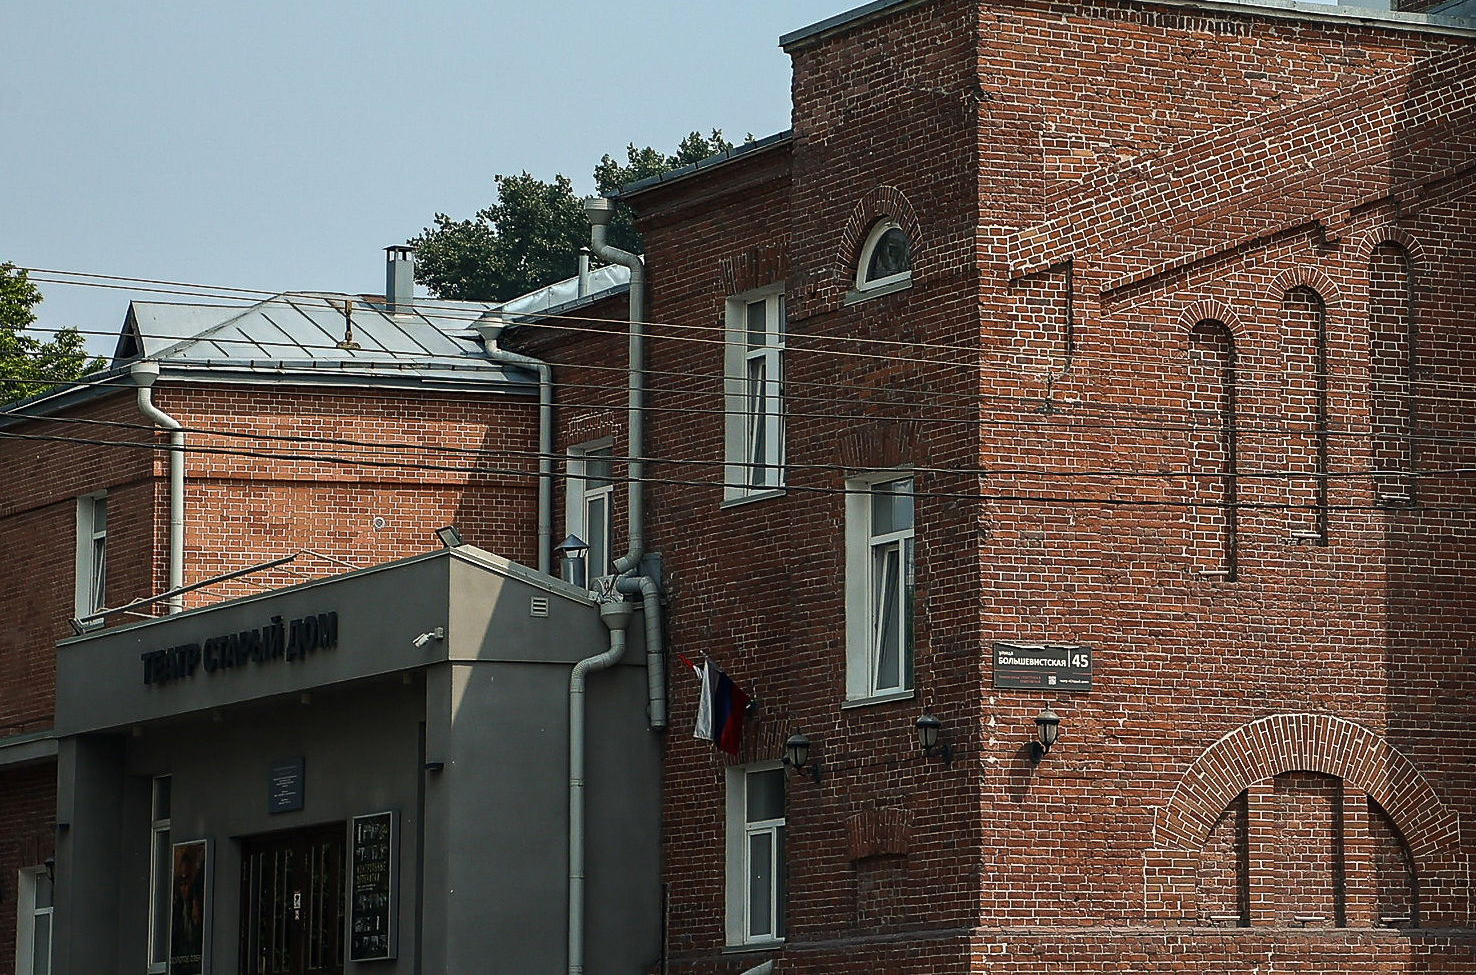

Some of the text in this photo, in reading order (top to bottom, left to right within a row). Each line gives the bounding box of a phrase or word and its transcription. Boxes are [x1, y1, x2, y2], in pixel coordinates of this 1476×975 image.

[141, 611, 338, 684] ТЕАТР СТАРЫЙ ДОМ
[998, 654, 1089, 668] БОЛЬШЕВИСТСКАЯ 45
